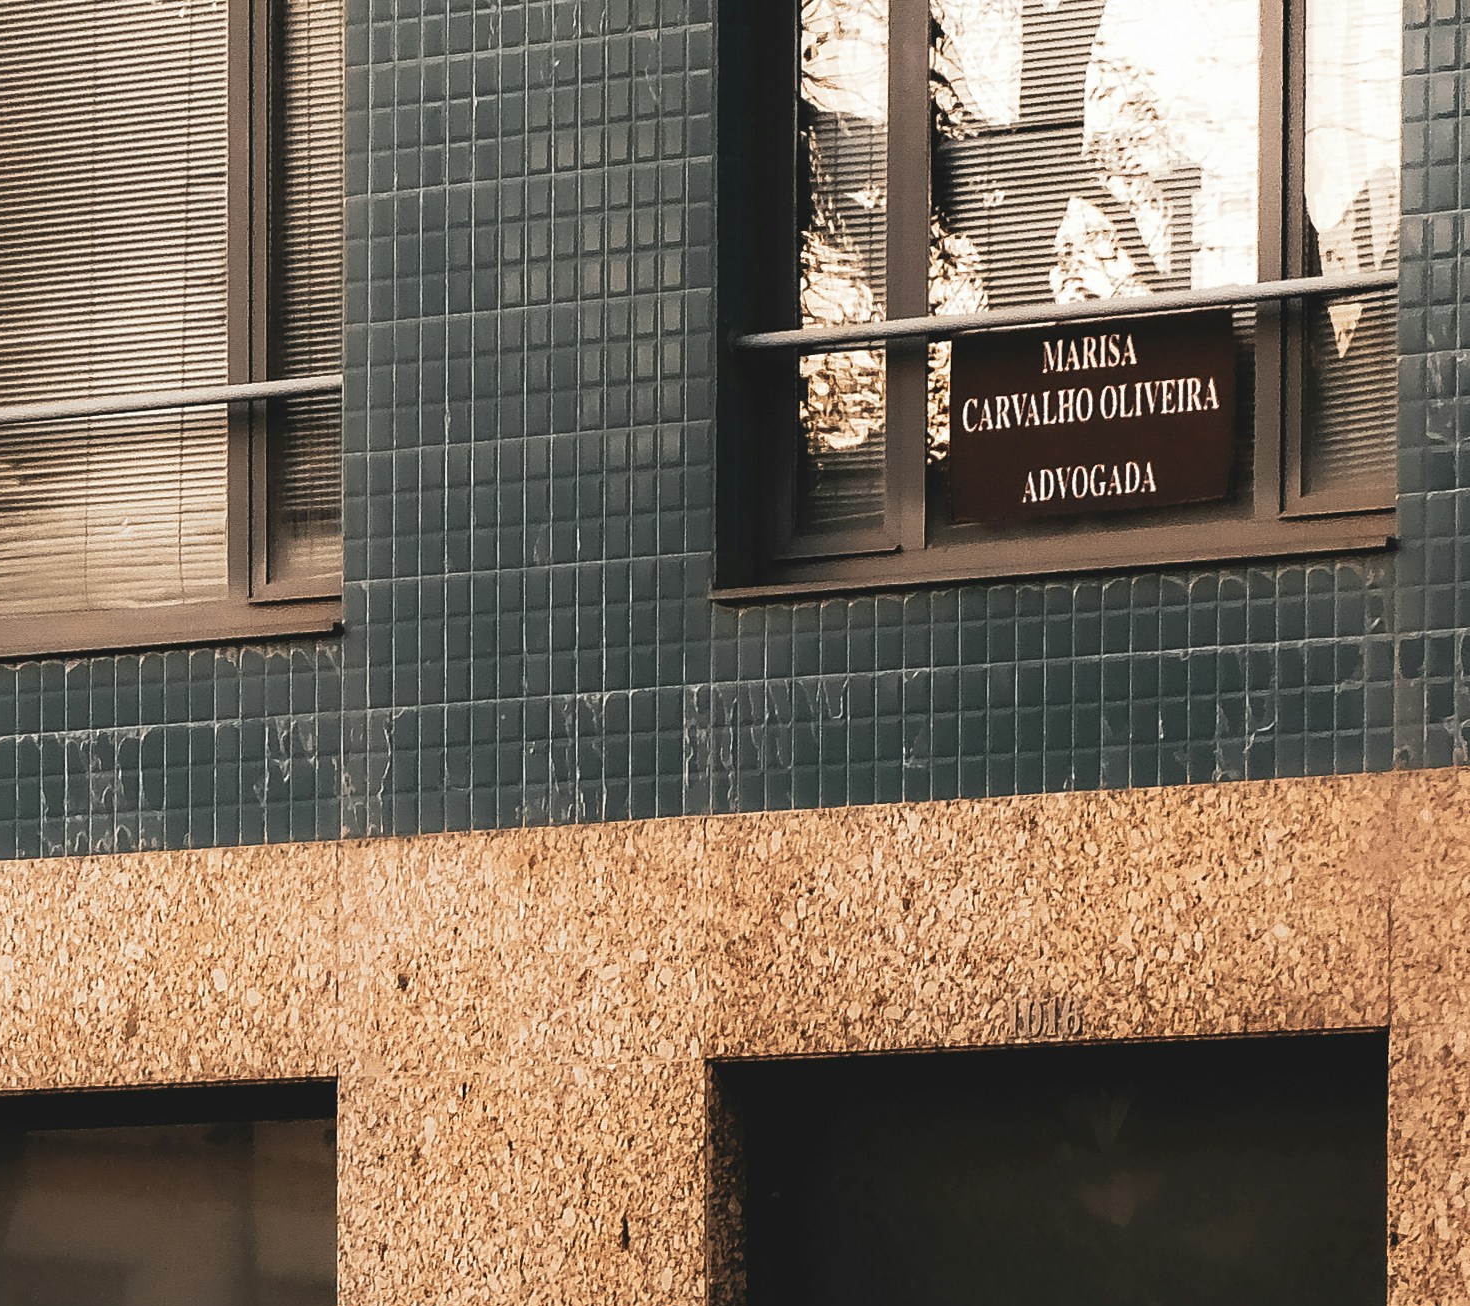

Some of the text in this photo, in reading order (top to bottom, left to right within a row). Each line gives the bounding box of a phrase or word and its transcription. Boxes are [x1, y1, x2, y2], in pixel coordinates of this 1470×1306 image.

[1041, 332, 1138, 374] MARISA
[961, 376, 1220, 433] CARVALHO OLIVEIRA
[1021, 460, 1157, 503] ADVOGADA
